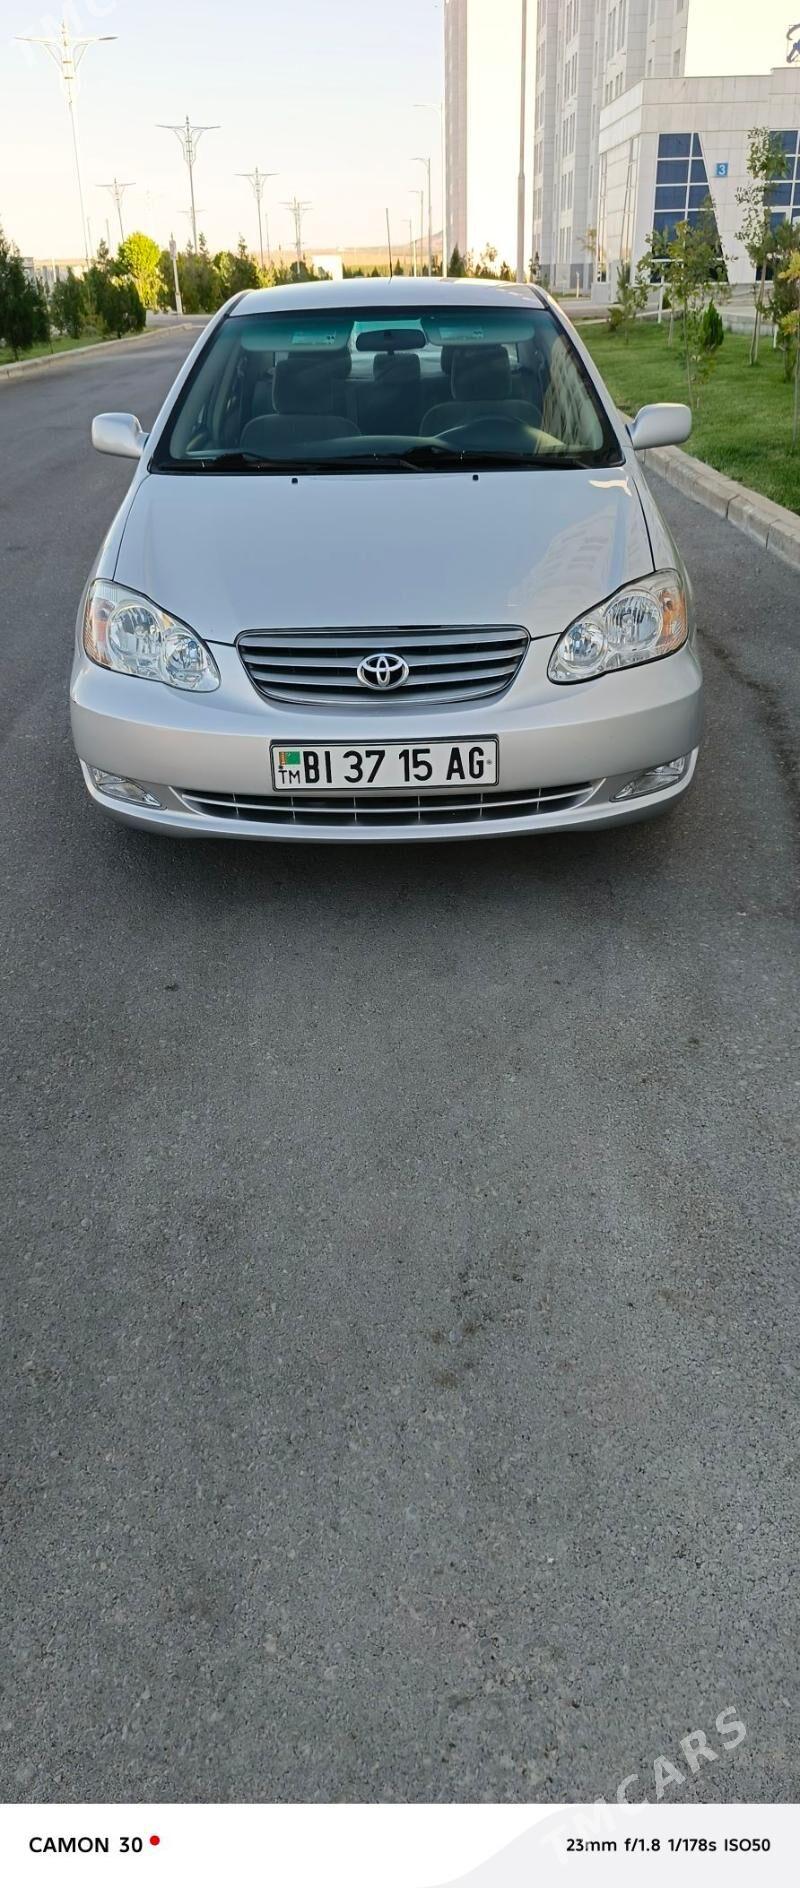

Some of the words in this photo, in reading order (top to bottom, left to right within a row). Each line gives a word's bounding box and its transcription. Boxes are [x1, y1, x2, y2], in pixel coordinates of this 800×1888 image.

[718, 164, 726, 175] 3
[342, 750, 386, 783] 37
[398, 748, 433, 782] 15
[446, 746, 485, 780] AG
[278, 769, 301, 785] TM
